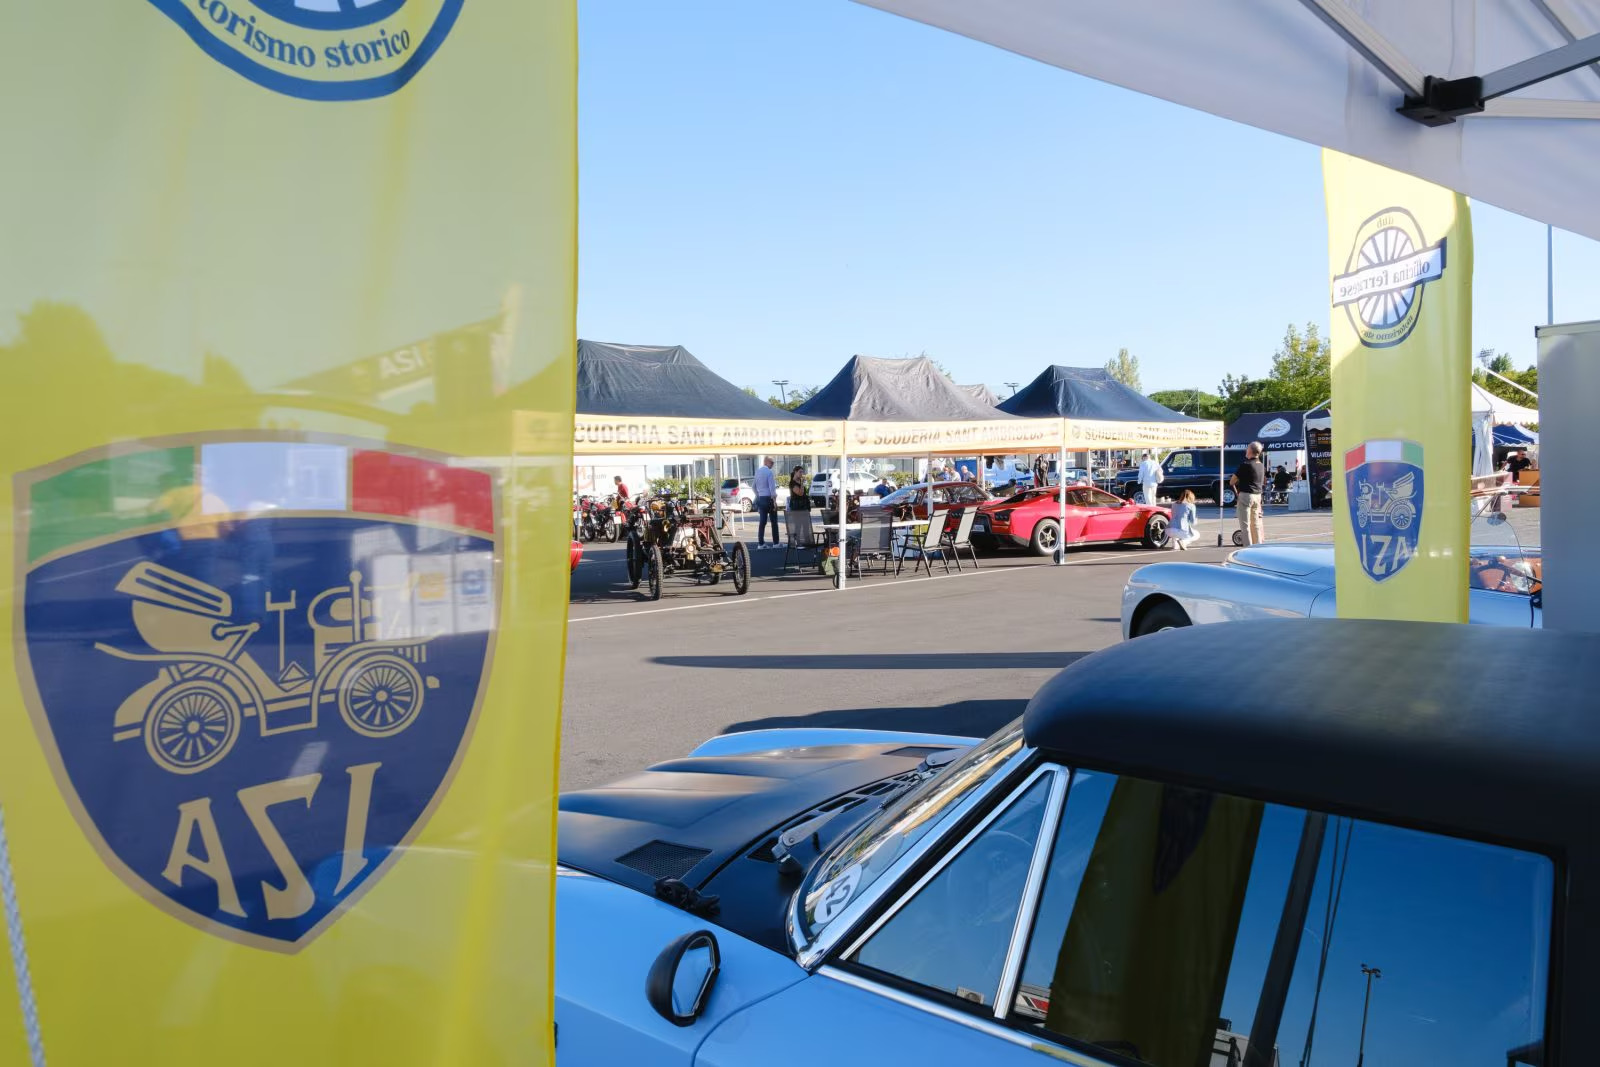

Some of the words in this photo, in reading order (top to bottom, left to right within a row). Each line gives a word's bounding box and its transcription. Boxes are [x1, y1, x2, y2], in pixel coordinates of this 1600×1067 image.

[324, 29, 410, 68] storico
[574, 423, 662, 444] CUDERIA
[667, 425, 716, 445] SANT
[722, 426, 814, 446] AMBROEUS
[873, 428, 942, 445] SCUDERIA
[1267, 441, 1305, 449] MOTORS
[160, 762, 383, 921] ASI
